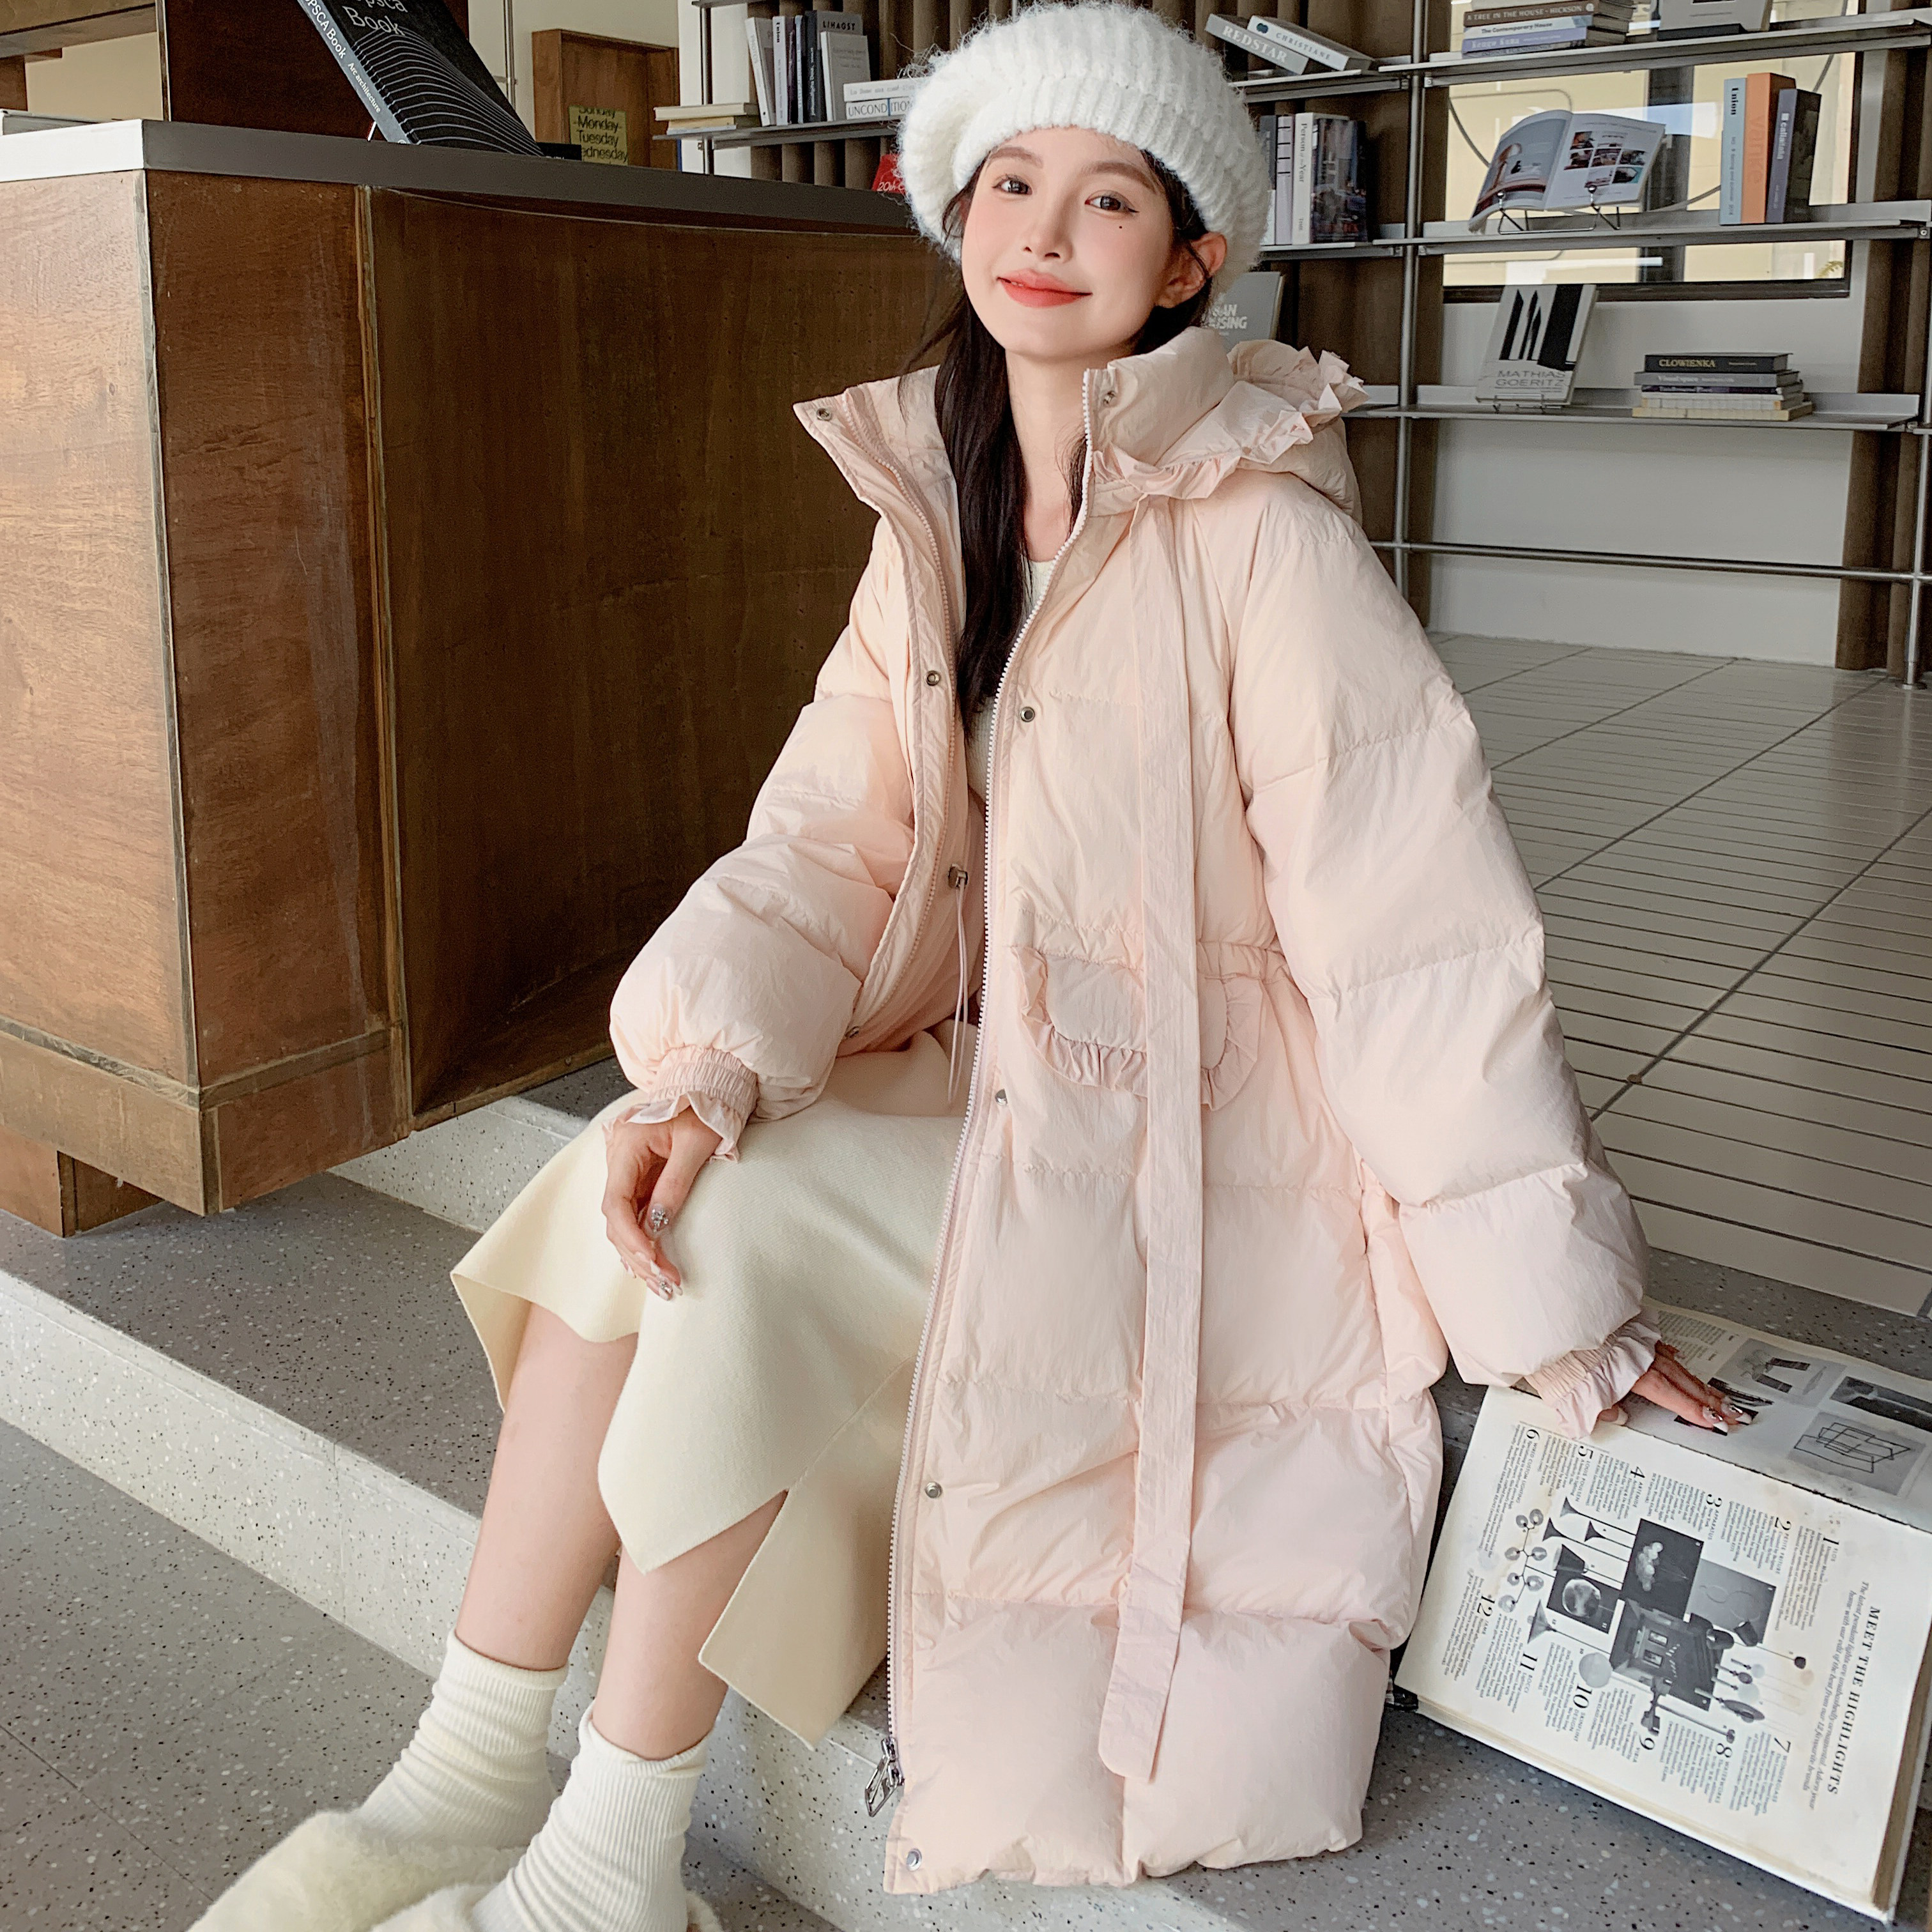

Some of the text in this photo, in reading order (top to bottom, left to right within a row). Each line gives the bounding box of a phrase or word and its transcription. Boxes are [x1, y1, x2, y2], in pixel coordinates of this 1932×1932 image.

[358, 0, 408, 13] psca
[1474, 12, 1492, 20] TREE
[1519, 8, 1545, 17] HOUSE
[305, 0, 346, 59] PSCA Book
[342, 6, 406, 36] Book
[1492, 24, 1533, 33] Contemporary
[348, 62, 381, 113] Arc architecture
[577, 116, 618, 133] Monday
[576, 130, 619, 148] Tuesday
[581, 146, 627, 162] ednesday
[1496, 378, 1564, 387] GOERITZ
[1515, 1427, 1542, 1503] 6 WIRED CUSTOM LIGHTING
[1575, 1445, 1593, 1502] 5 LOUIS POULSEN
[1629, 1465, 1647, 1508] 4 ARTEMIDE
[1705, 1493, 1723, 1540] 3 APPARATUS
[1774, 1517, 1792, 1531] 2
[1822, 1537, 1839, 1545] 1
[1859, 1581, 1869, 1595] The
[1476, 1596, 1496, 1617] 12
[1855, 1595, 1865, 1614] latest
[1842, 1610, 1852, 1627] with
[1846, 1613, 1860, 1643] pendant
[1831, 1653, 1841, 1662] of
[1842, 1643, 1854, 1664] lights
[1519, 1652, 1538, 1693] 11 BOCCI
[1830, 1661, 1839, 1674] the
[1827, 1674, 1836, 1689] best
[1821, 1687, 1832, 1707] from
[1828, 1606, 1880, 1795] MEET THE HIGHLIGHTS
[1568, 1708, 1579, 1731] DESIGN
[1571, 1683, 1593, 1742] 10 SKINFLINT
[1817, 1721, 1825, 1730] 12
[1636, 1735, 1656, 1751] 9
[1713, 1742, 1734, 1758] 8
[1771, 1737, 1791, 1753] 7
[1807, 1728, 1823, 1765] favourite
[1802, 1765, 1814, 1791] brands
[1813, 1767, 1825, 1792] Adorn
[1807, 1791, 1818, 1809] your
